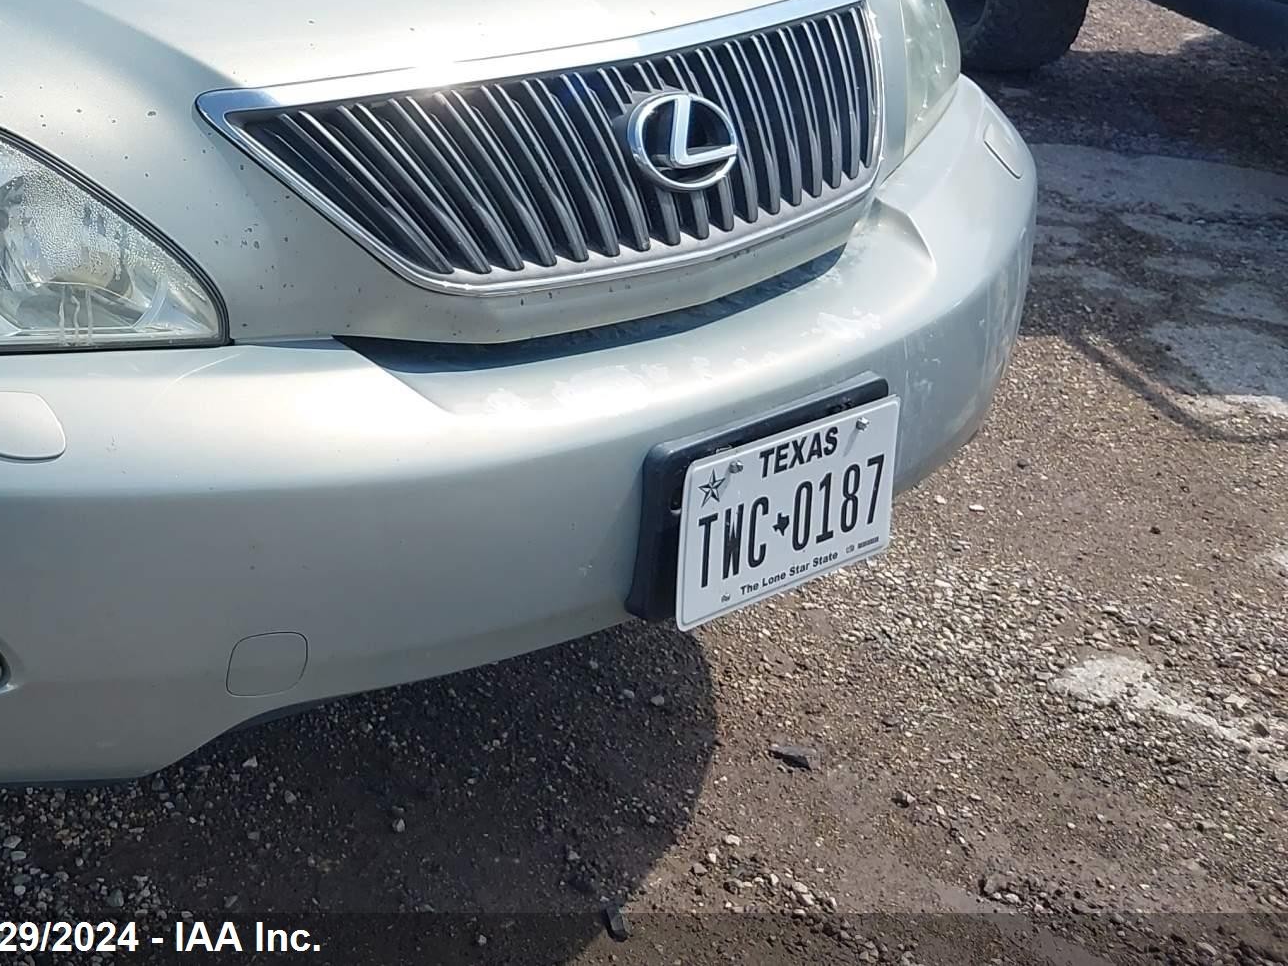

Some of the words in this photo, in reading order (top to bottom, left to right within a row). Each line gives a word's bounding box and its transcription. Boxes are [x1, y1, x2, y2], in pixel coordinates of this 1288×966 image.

[759, 426, 838, 478] TEXAS
[698, 496, 769, 588] TWC
[792, 454, 885, 551] 0187
[740, 582, 759, 595] The
[762, 572, 786, 587] Lone
[789, 562, 810, 577] Star
[812, 551, 838, 568] State
